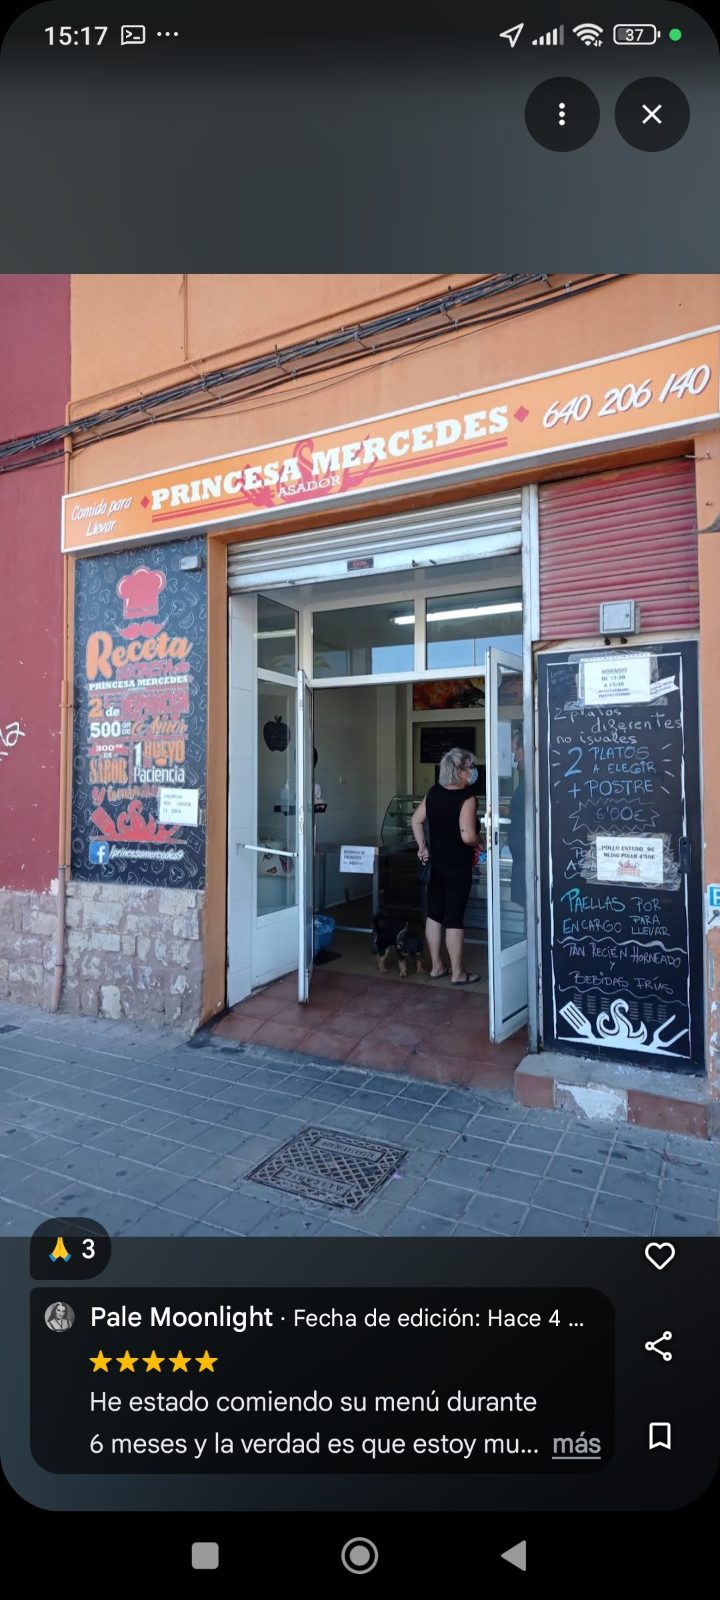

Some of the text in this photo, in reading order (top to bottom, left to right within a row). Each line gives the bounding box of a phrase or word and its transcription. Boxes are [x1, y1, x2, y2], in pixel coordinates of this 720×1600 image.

[542, 364, 710, 428] 640 206 140
[151, 405, 508, 511] PRINCESA MERCEDES
[277, 475, 341, 498] ASADOR
[71, 496, 132, 521] Comida para
[85, 520, 117, 537] Llevar
[86, 631, 193, 680] Receta
[88, 679, 135, 690] PRINCESA
[138, 675, 188, 686] MERCEDES
[88, 698, 120, 718] 2 de
[553, 708, 566, 720] 2
[90, 721, 121, 738] 500
[556, 736, 572, 744] no
[564, 746, 650, 777] 2 PLATOS
[134, 765, 186, 784] Paciencia
[584, 780, 654, 798] POSTRE
[561, 888, 661, 913] PAELLAS POR
[562, 915, 660, 934] ENCARGO PARA
[631, 926, 671, 937] LLEVAR
[563, 943, 586, 957] PAN
[630, 946, 681, 968] HORNEADO
[569, 971, 629, 987] BEBIDAS
